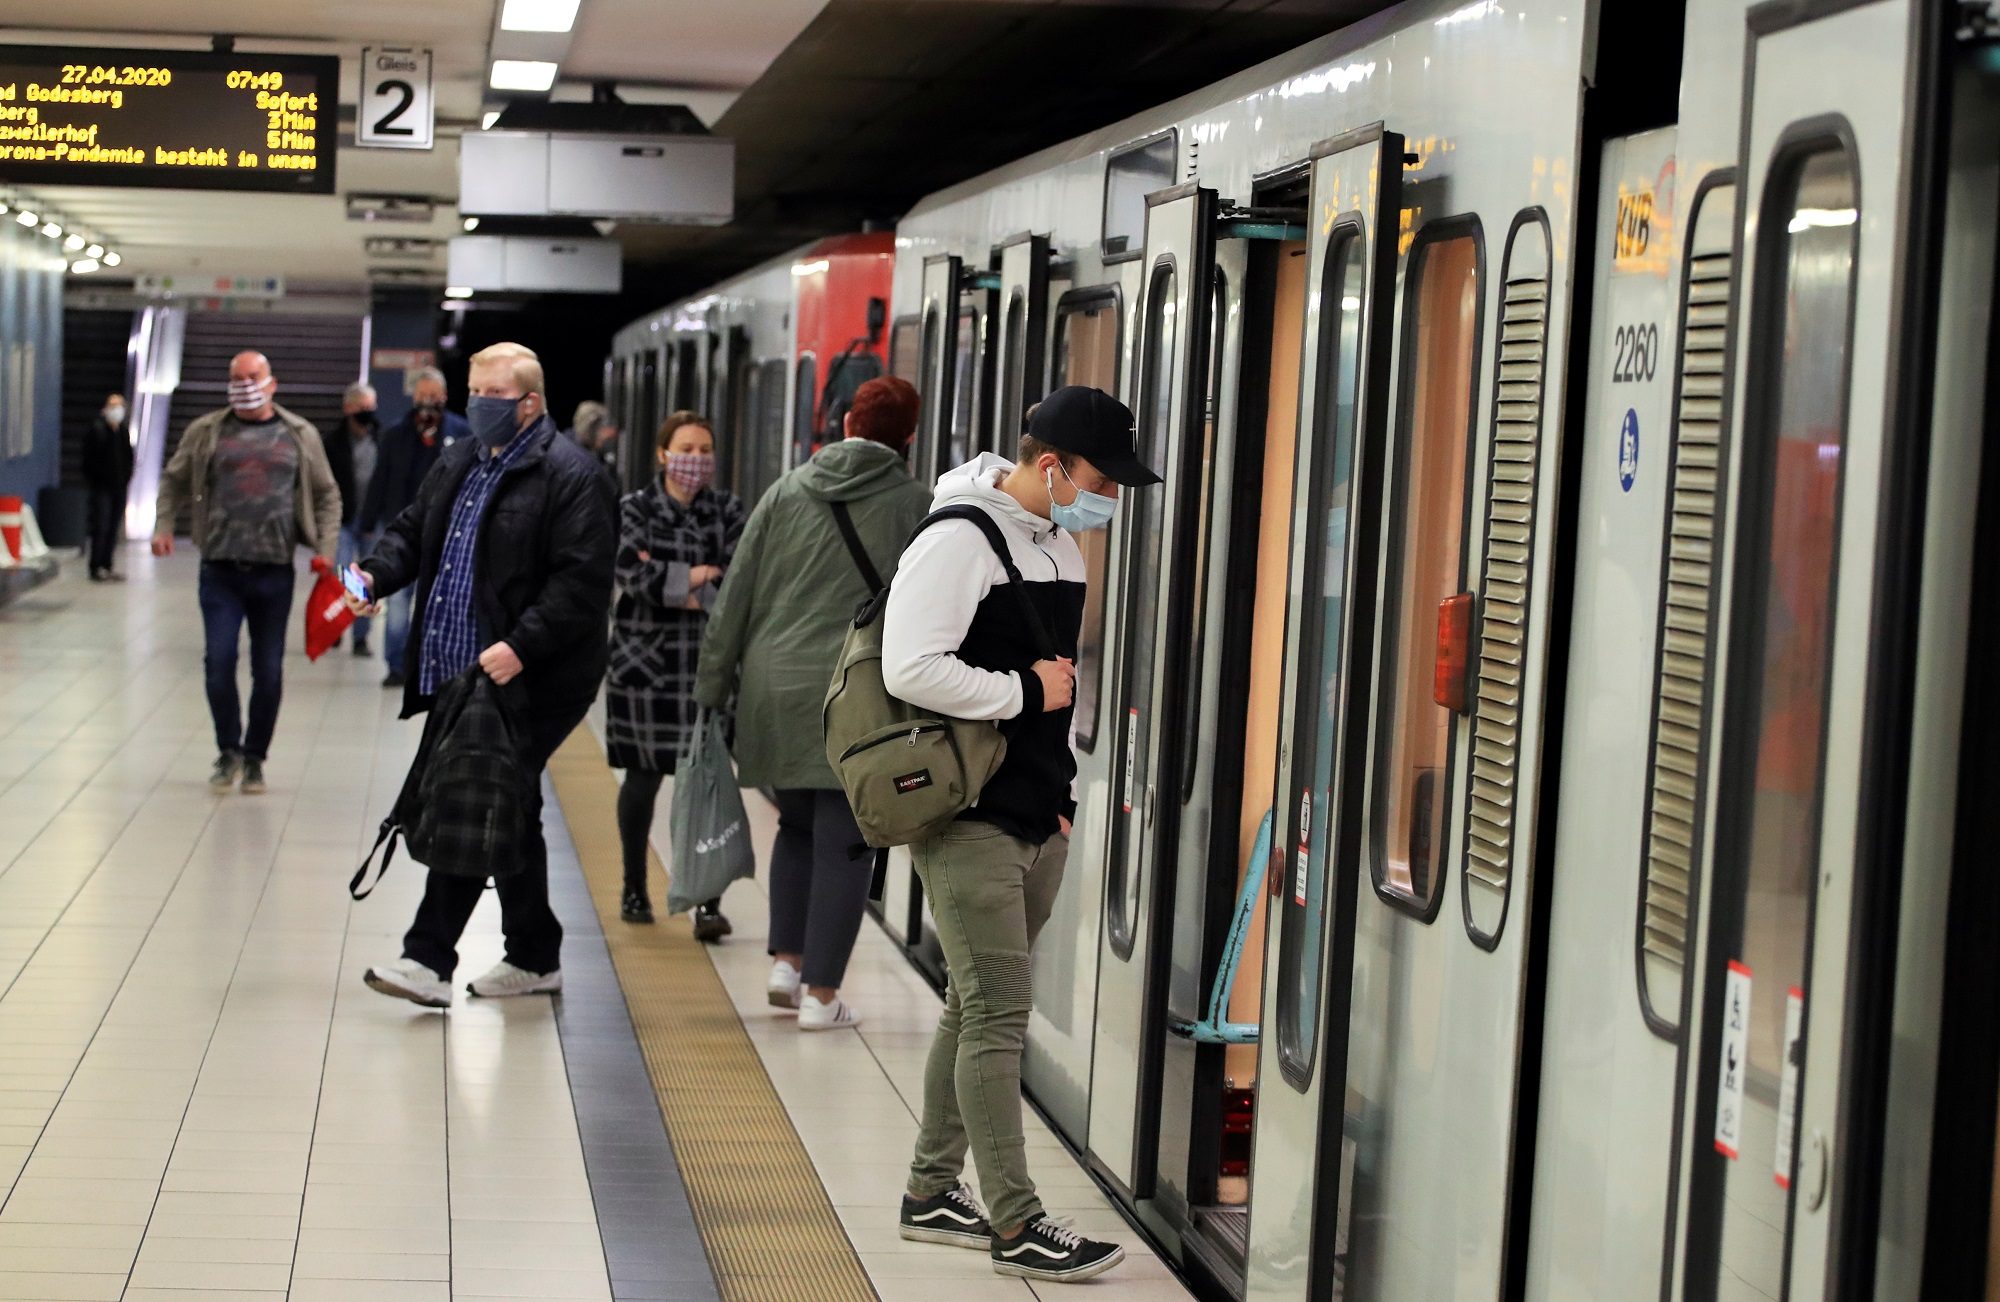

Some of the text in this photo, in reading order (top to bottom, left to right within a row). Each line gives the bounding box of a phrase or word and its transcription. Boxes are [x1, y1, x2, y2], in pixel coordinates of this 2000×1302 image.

[61, 65, 283, 90] 27.04.2020 07:49
[376, 56, 417, 72] Gleis
[26, 83, 123, 109] Godesberg
[256, 91, 318, 114] Sofort
[373, 80, 414, 135] 2
[155, 146, 228, 167] besteht
[237, 151, 258, 168] in
[1613, 192, 1652, 260] KVB
[1612, 322, 1658, 383] 2260
